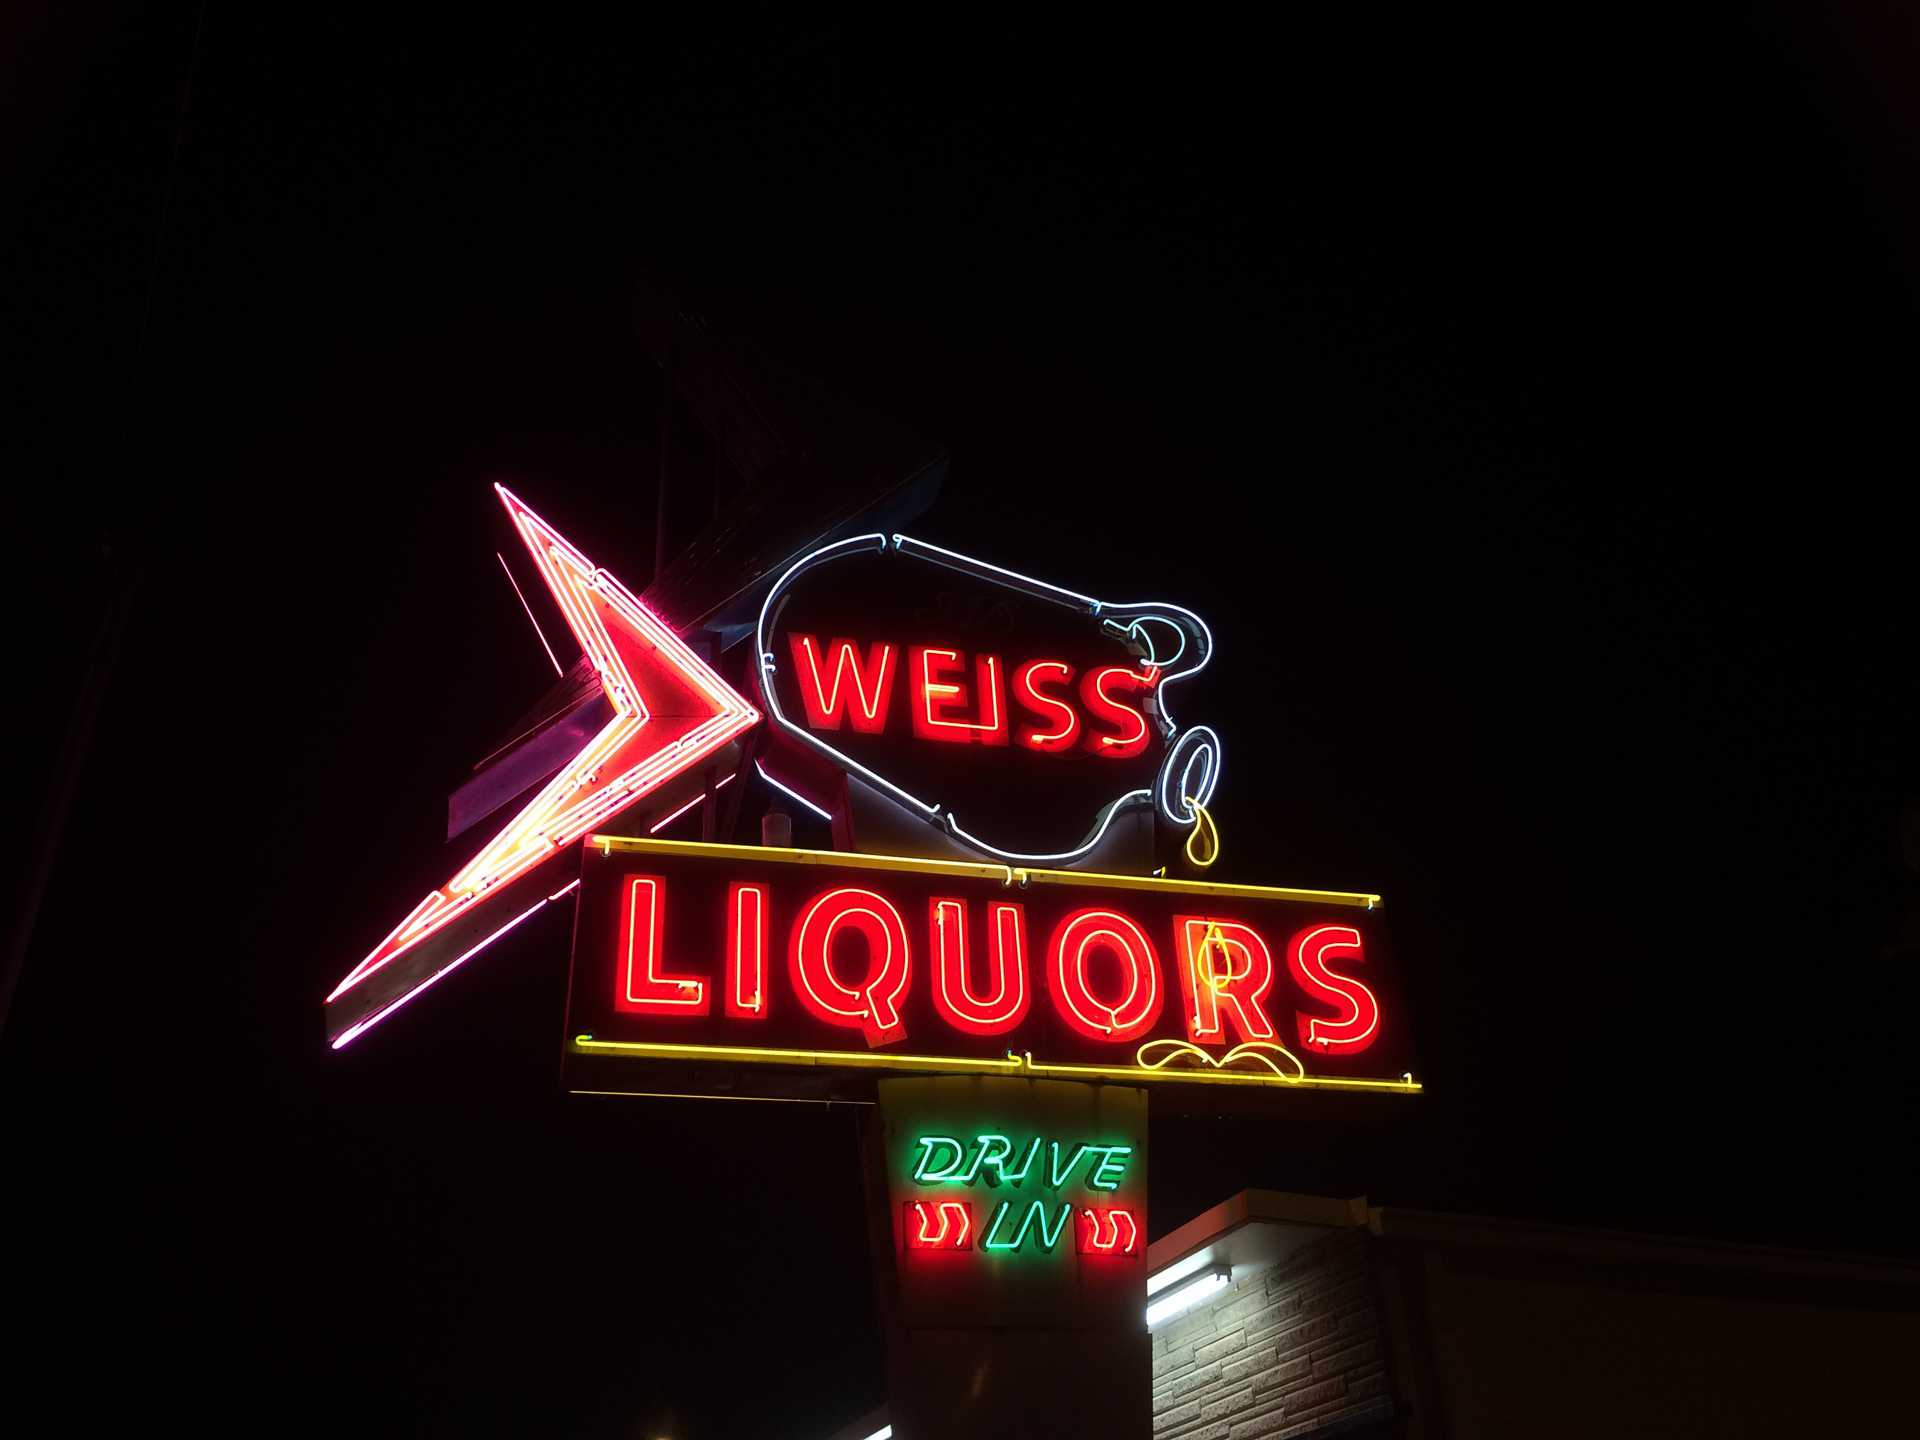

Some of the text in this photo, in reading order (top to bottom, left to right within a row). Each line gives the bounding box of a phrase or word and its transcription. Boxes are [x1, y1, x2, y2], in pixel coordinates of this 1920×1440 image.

[788, 633, 1156, 758] WEISS
[615, 875, 1380, 1054] LIQUORS
[913, 1135, 1132, 1191] DRIVE
[979, 1200, 1072, 1252] IN
